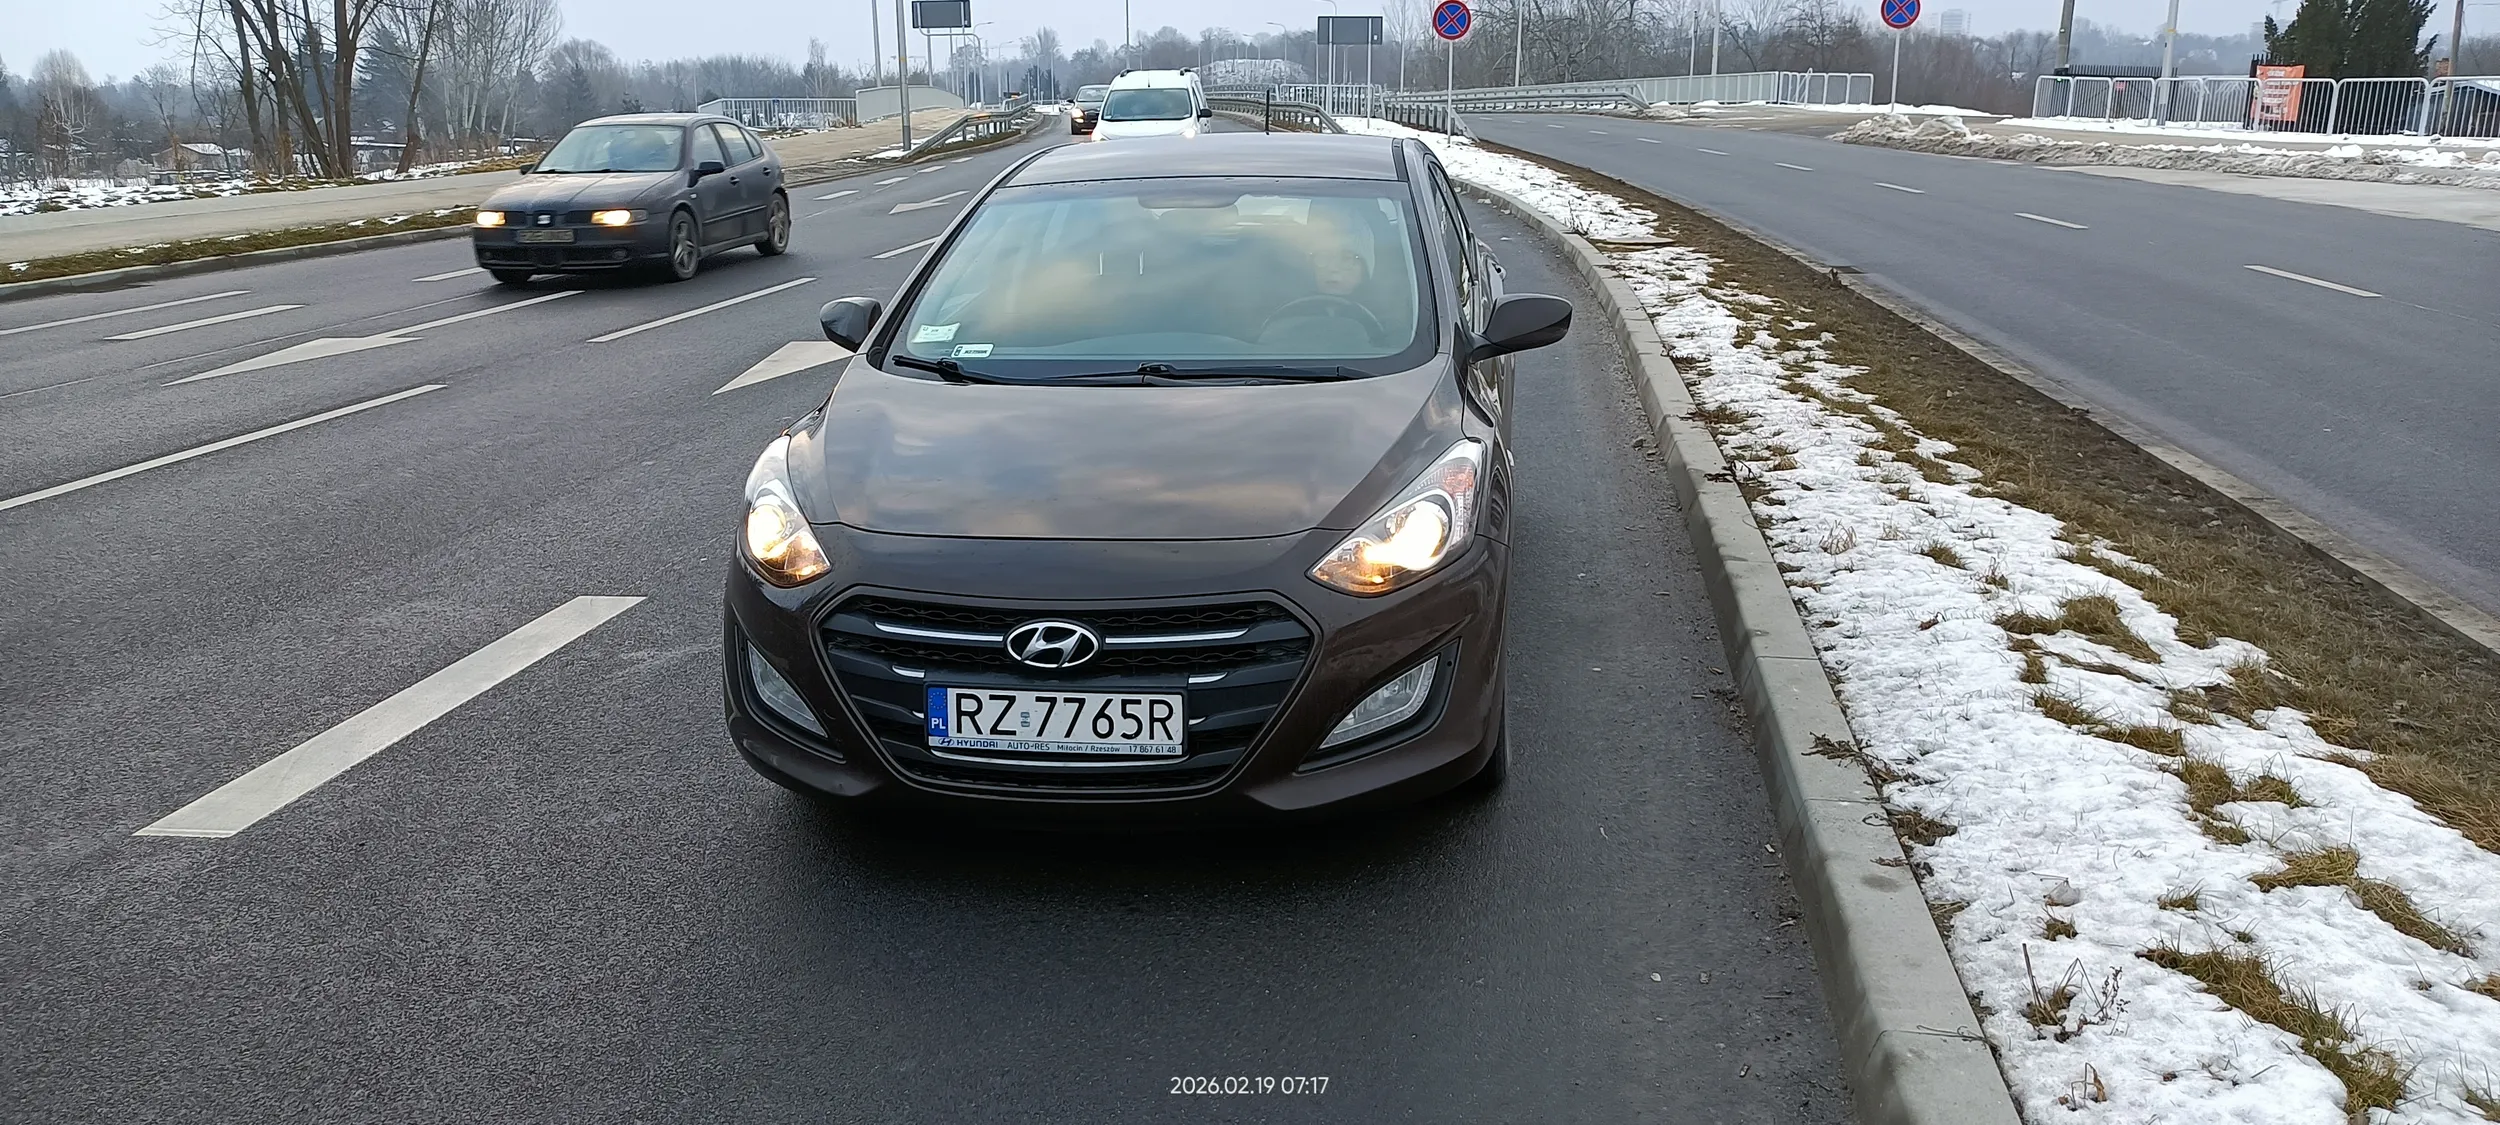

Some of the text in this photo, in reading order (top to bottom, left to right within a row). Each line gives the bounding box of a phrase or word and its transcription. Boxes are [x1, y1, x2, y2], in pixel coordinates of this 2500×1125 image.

[955, 692, 1174, 740] RZ 7765R
[931, 717, 946, 730] PL
[957, 740, 998, 748] HYUNDAI
[1007, 741, 1050, 751] AUTO-RES
[1090, 745, 1121, 753] Rzeszów
